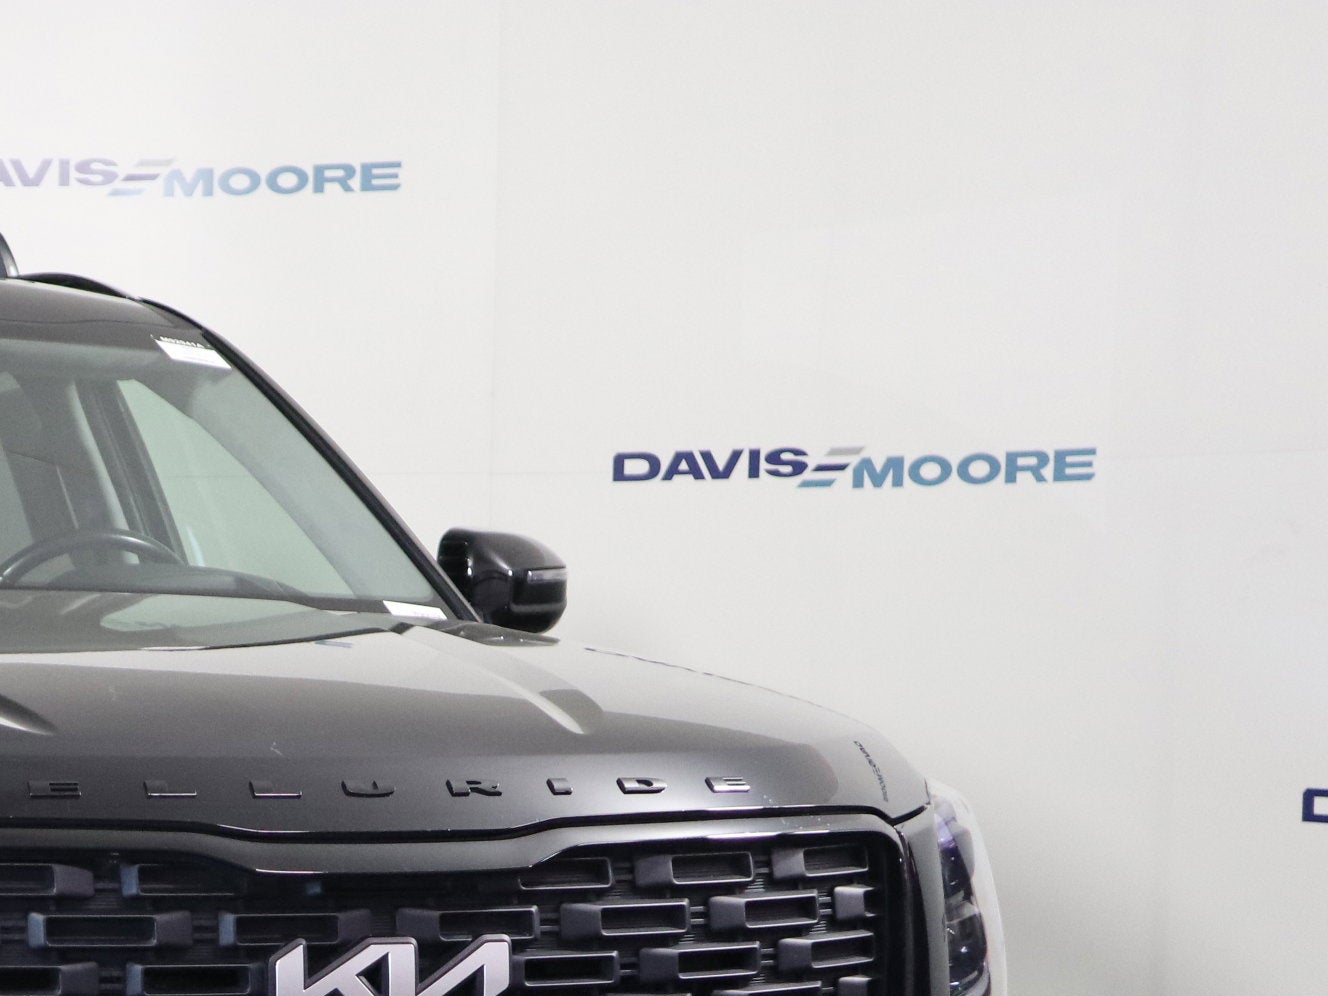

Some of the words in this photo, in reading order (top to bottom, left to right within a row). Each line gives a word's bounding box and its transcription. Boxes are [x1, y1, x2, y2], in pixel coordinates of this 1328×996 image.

[163, 160, 403, 198] MOORE
[612, 447, 809, 482] DAVIS
[851, 448, 1097, 489] MOORE
